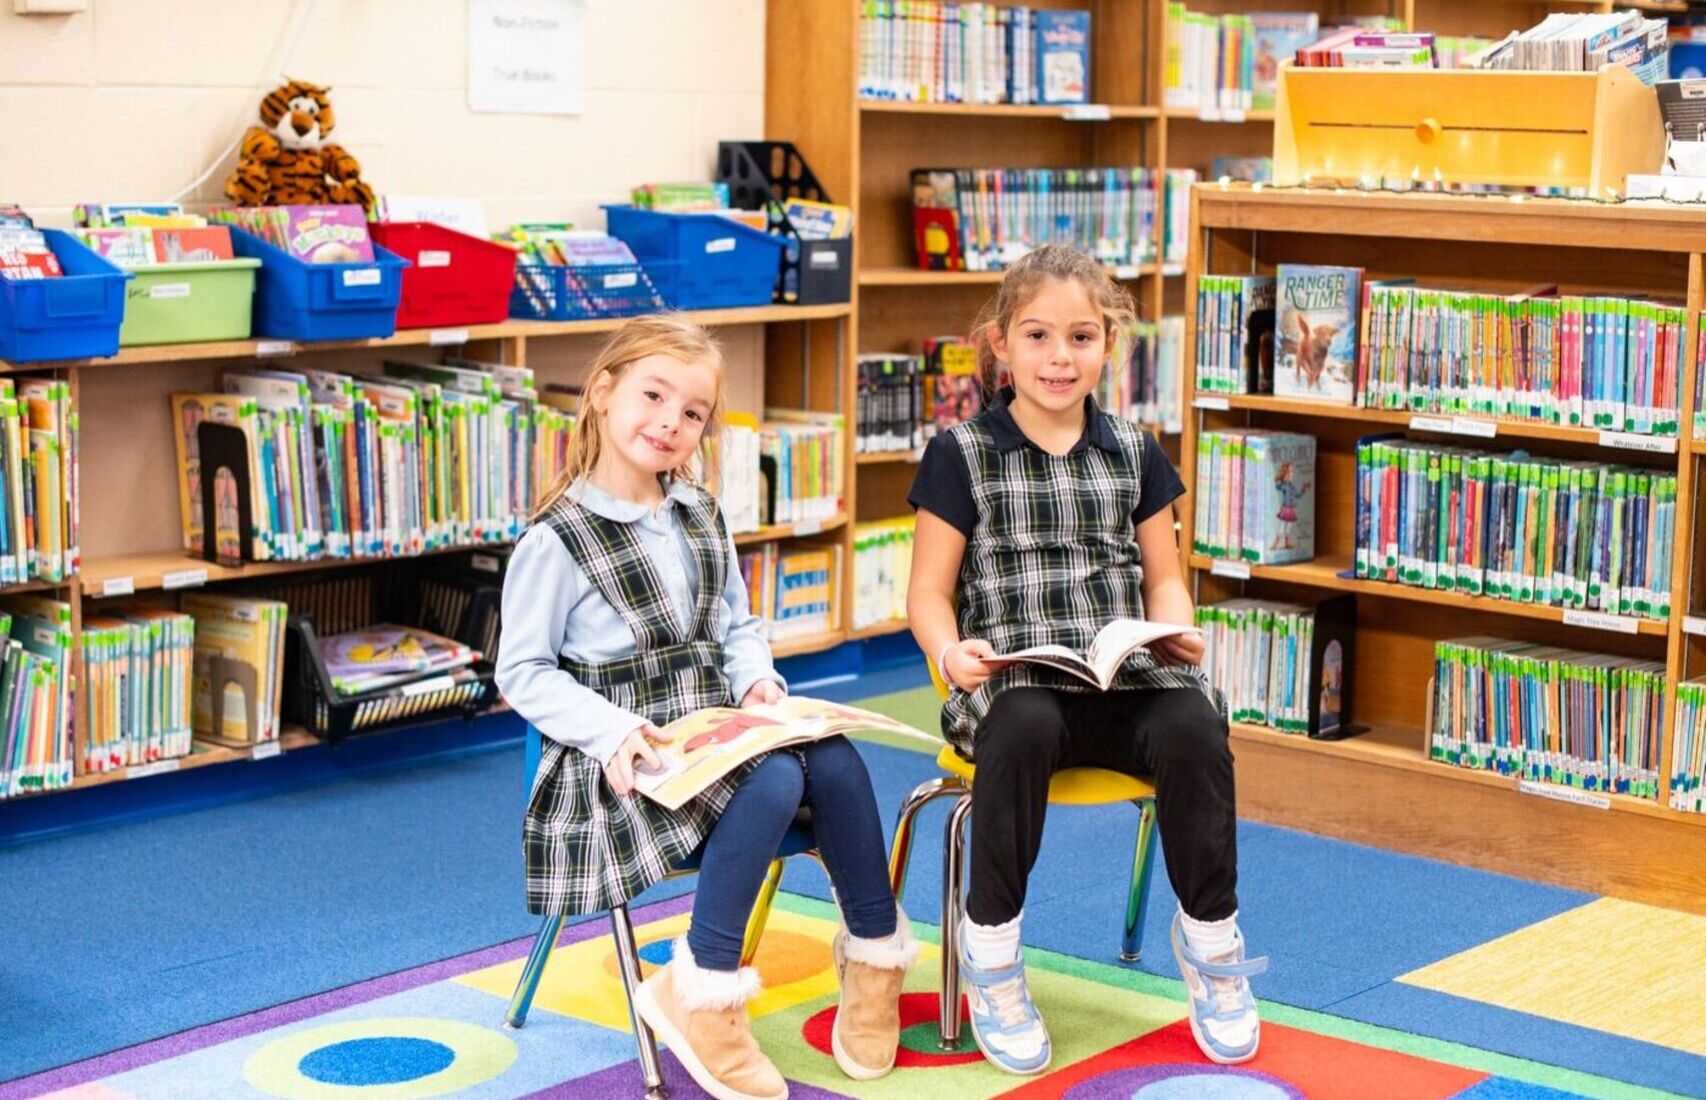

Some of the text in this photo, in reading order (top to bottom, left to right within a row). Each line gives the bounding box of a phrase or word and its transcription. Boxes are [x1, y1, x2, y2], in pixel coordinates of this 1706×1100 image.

[1285, 273, 1345, 301] RANGER
[1305, 290, 1345, 309] TIME
[1613, 439, 1662, 450] Whatever After
